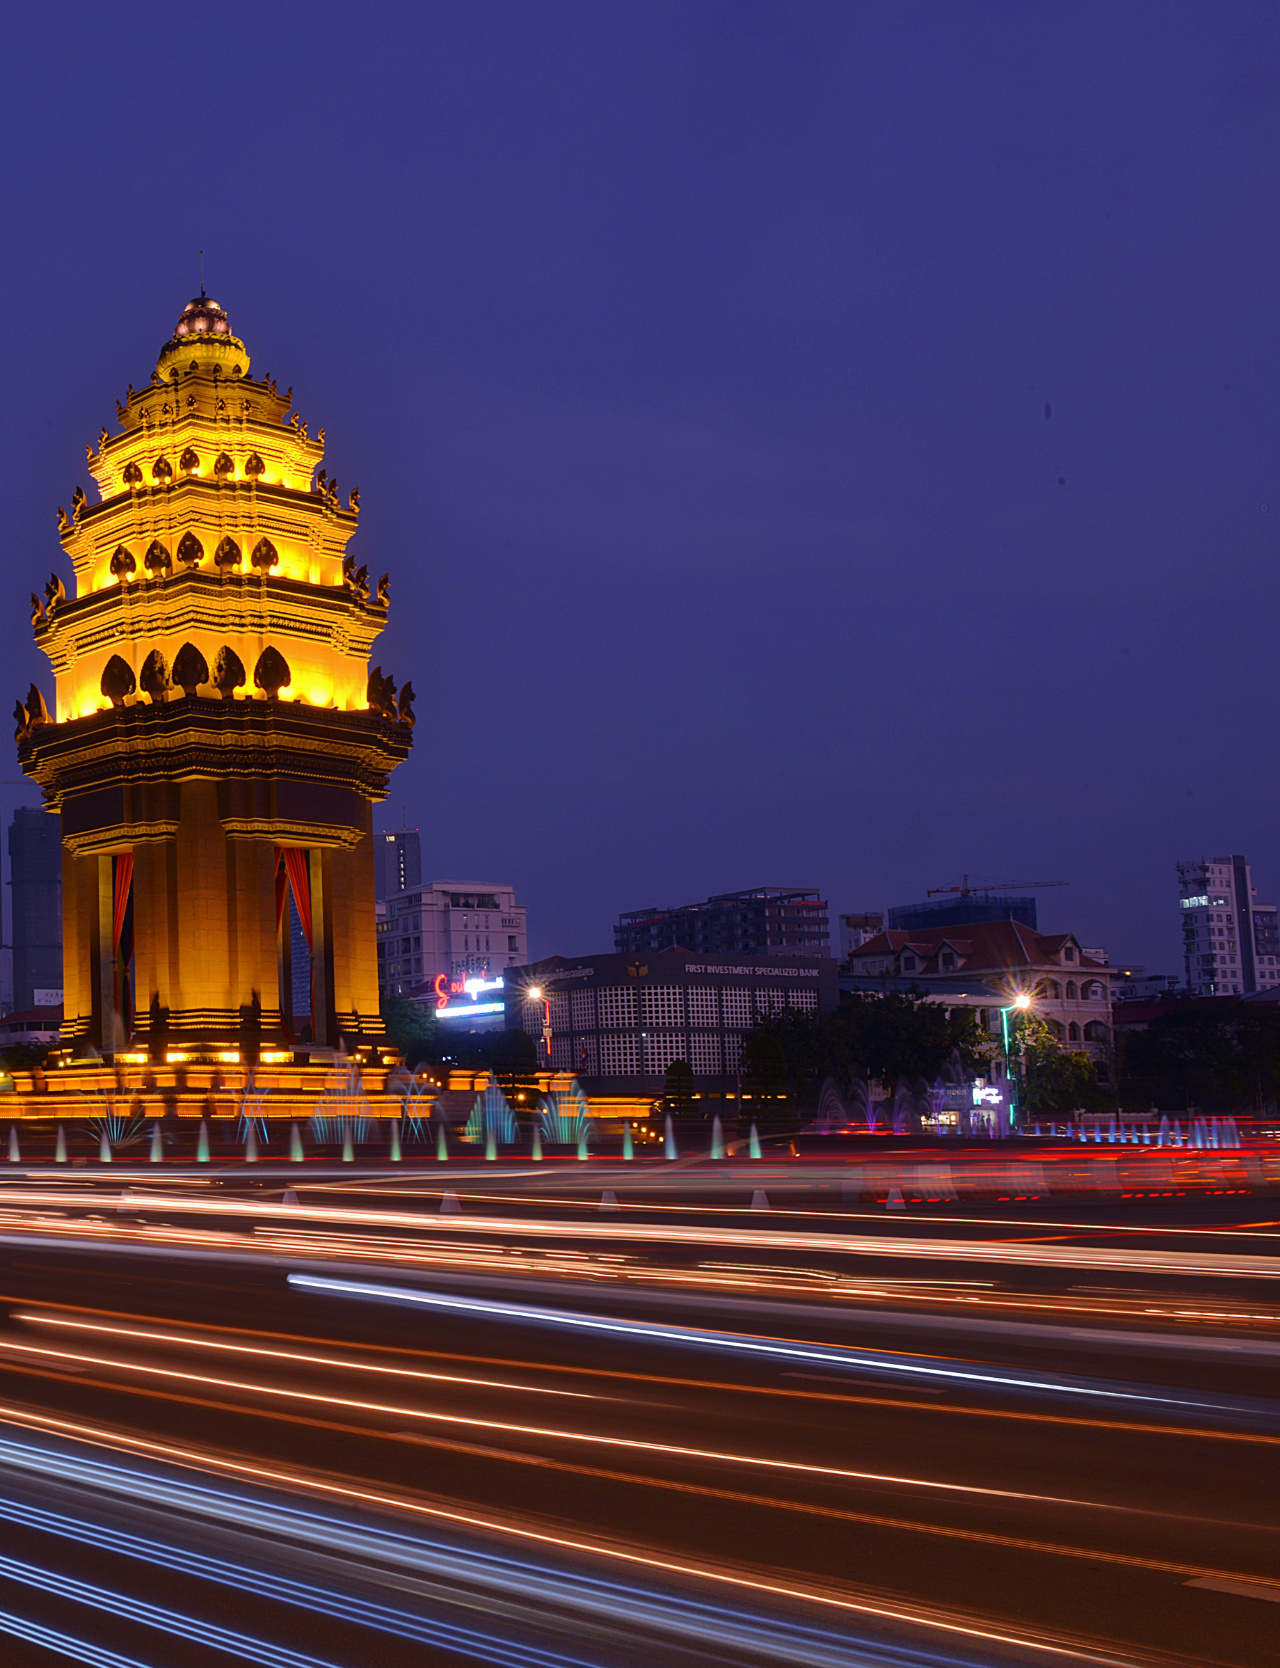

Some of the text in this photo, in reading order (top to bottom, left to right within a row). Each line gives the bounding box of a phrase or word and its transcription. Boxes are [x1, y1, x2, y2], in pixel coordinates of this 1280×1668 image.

[685, 964, 819, 977] FIRST INVESTMENT SPECIALIZED BANK
